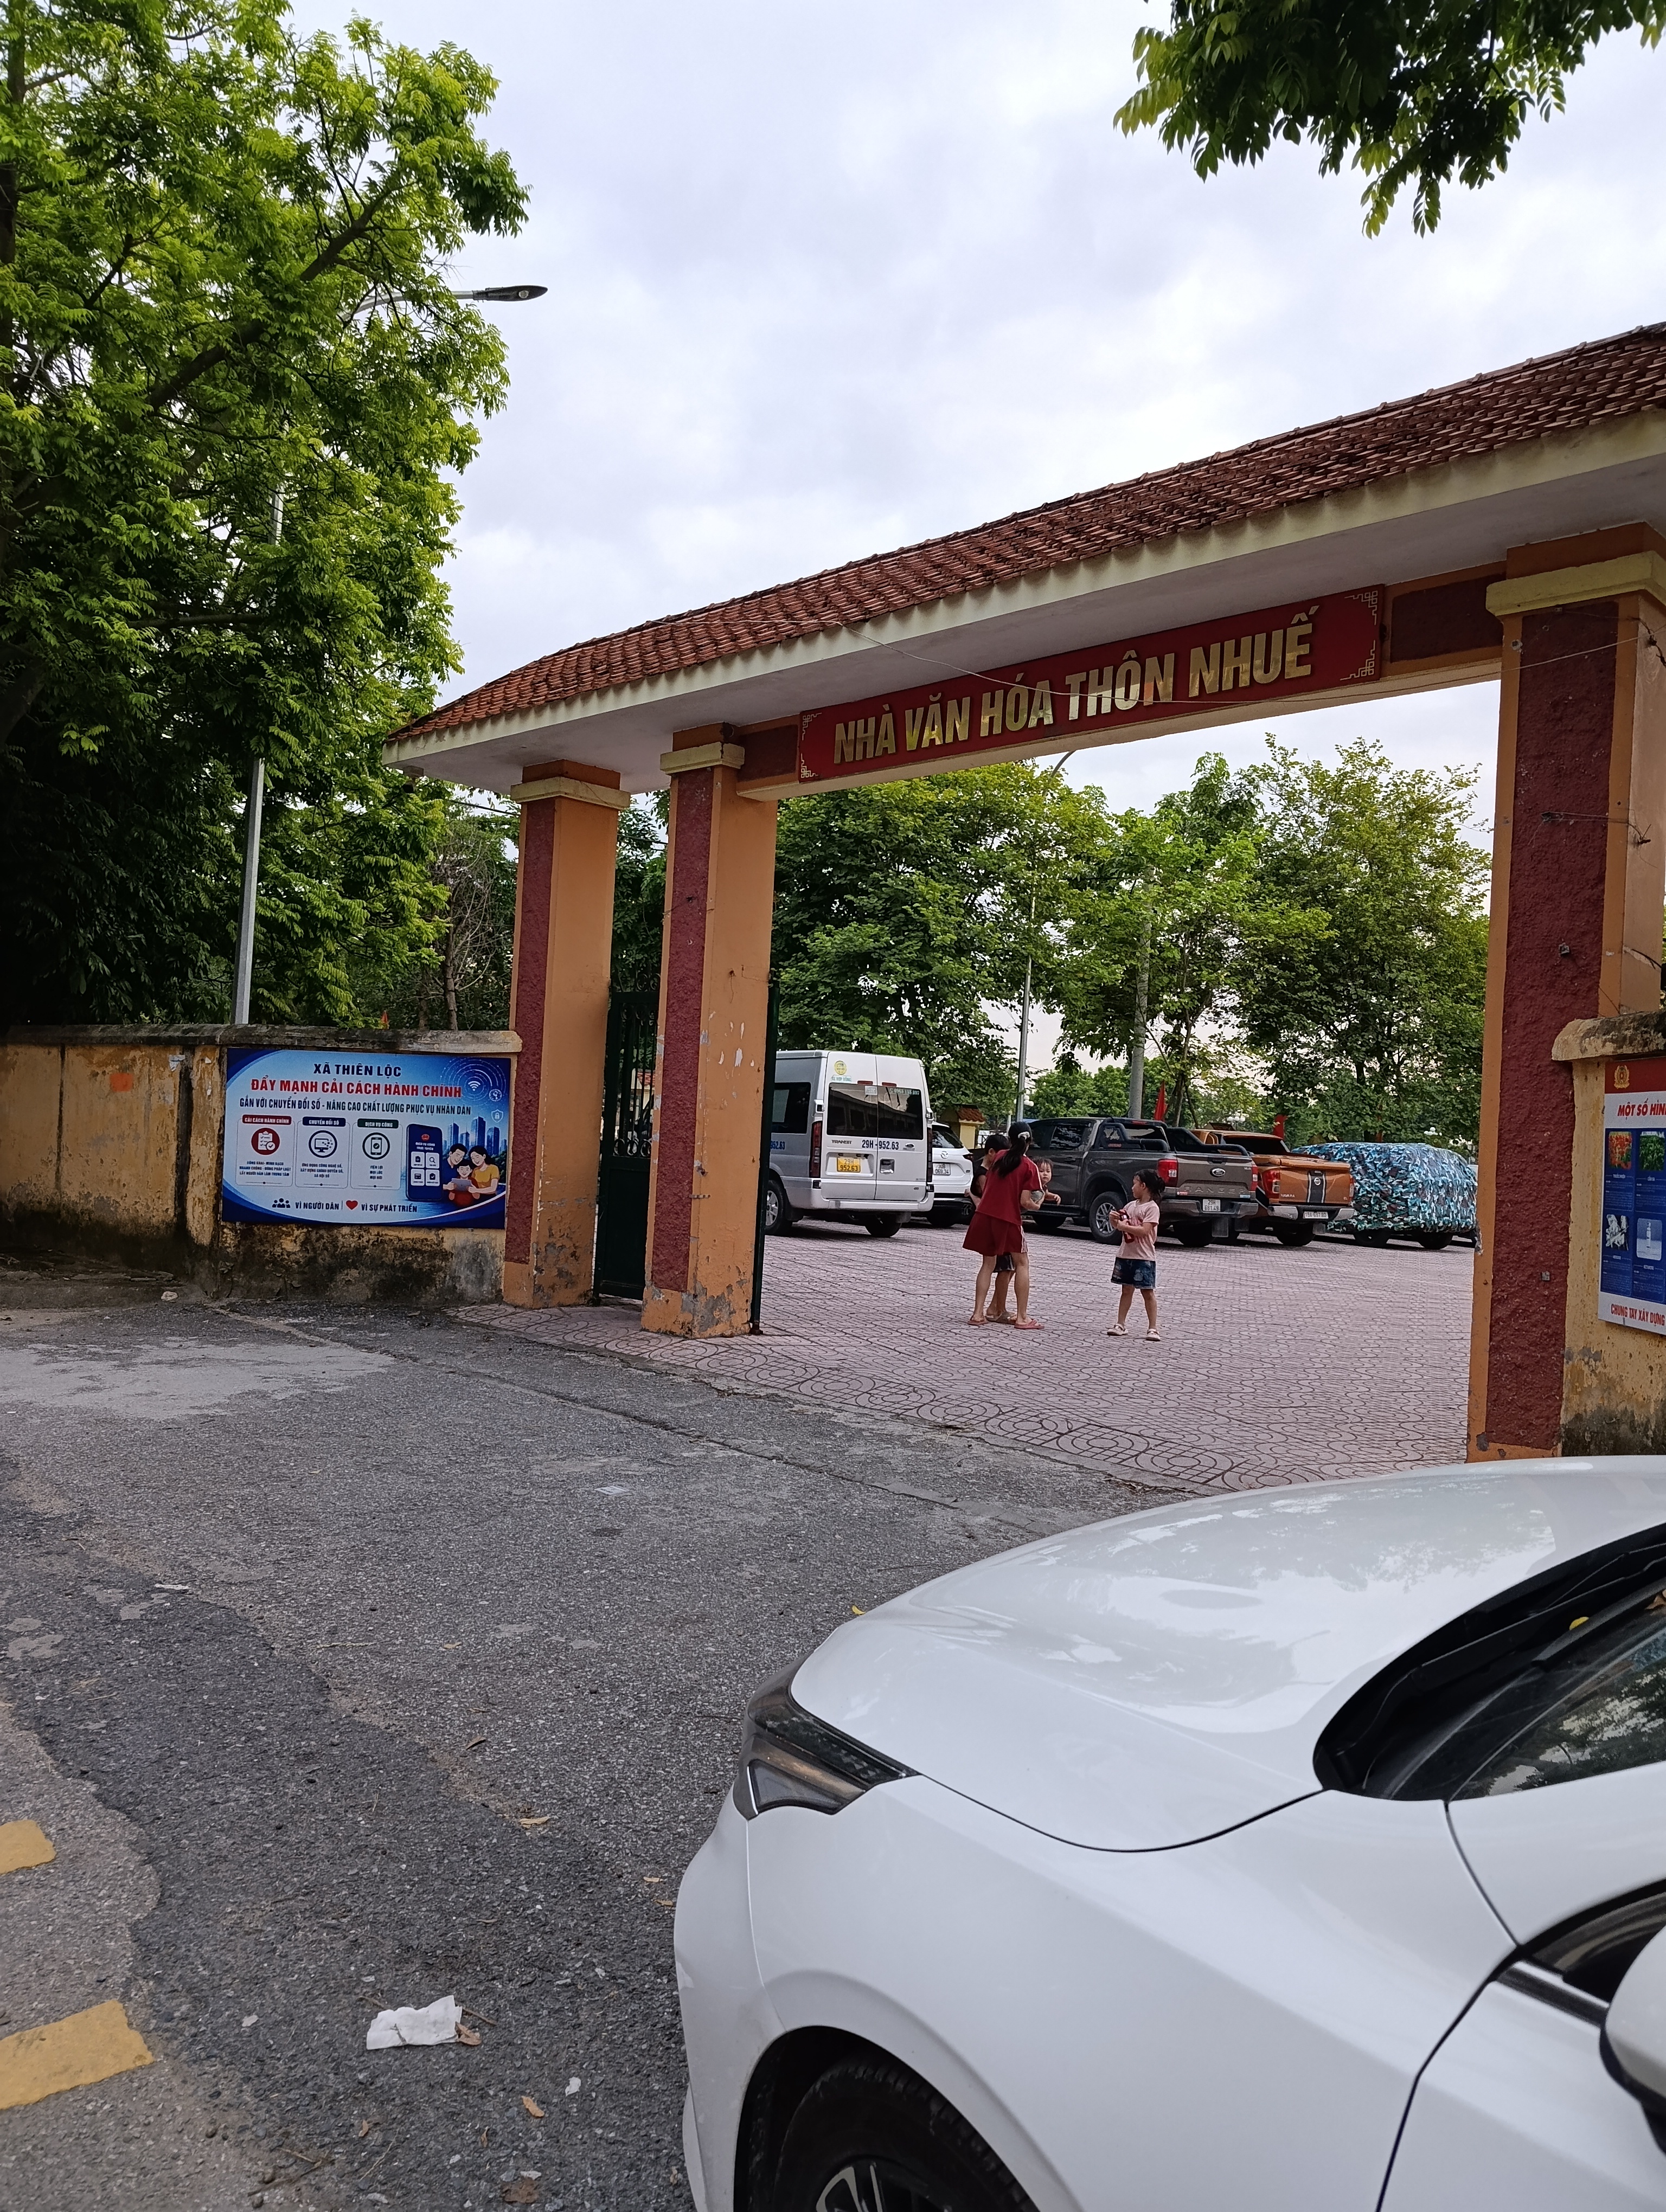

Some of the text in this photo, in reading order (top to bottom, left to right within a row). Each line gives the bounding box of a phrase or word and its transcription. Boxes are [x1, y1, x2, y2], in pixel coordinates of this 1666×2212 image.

[834, 606, 1320, 765] NHÀ VĂN HÓA THÔN NHUẾ
[313, 1062, 401, 1078] XÃ THIÊN LỘC
[251, 1075, 461, 1097] ĐẨY MẠNH CẢI CÁCH HÀNH CHÍNH
[240, 1095, 254, 1107] GẮN
[256, 1097, 267, 1108] VỚI
[269, 1096, 296, 1109] CHUYỂN
[298, 1097, 309, 1109] ĐỔI
[311, 1098, 321, 1110] SỐ
[326, 1099, 345, 1110] NÂNG
[348, 1102, 361, 1111] CAO
[363, 1099, 380, 1111] CHẤT
[382, 1102, 404, 1114] LƯỢNG
[407, 1104, 424, 1115] PHỤC
[426, 1105, 434, 1116] VỤ
[436, 1104, 455, 1115] NHÂN
[457, 1104, 471, 1115] DÂN
[1617, 1098, 1666, 1120] MỘT SỐ HÌN
[862, 1139, 874, 1149] 29H
[879, 1140, 899, 1150] 952.63
[295, 1201, 339, 1210] VÌ NGƯỜI DÂN
[361, 1203, 418, 1213] VÌ SỰ PHÁT TRIỂN
[1611, 1303, 1665, 1327] CHUNG TAY XÂY DỰNG
